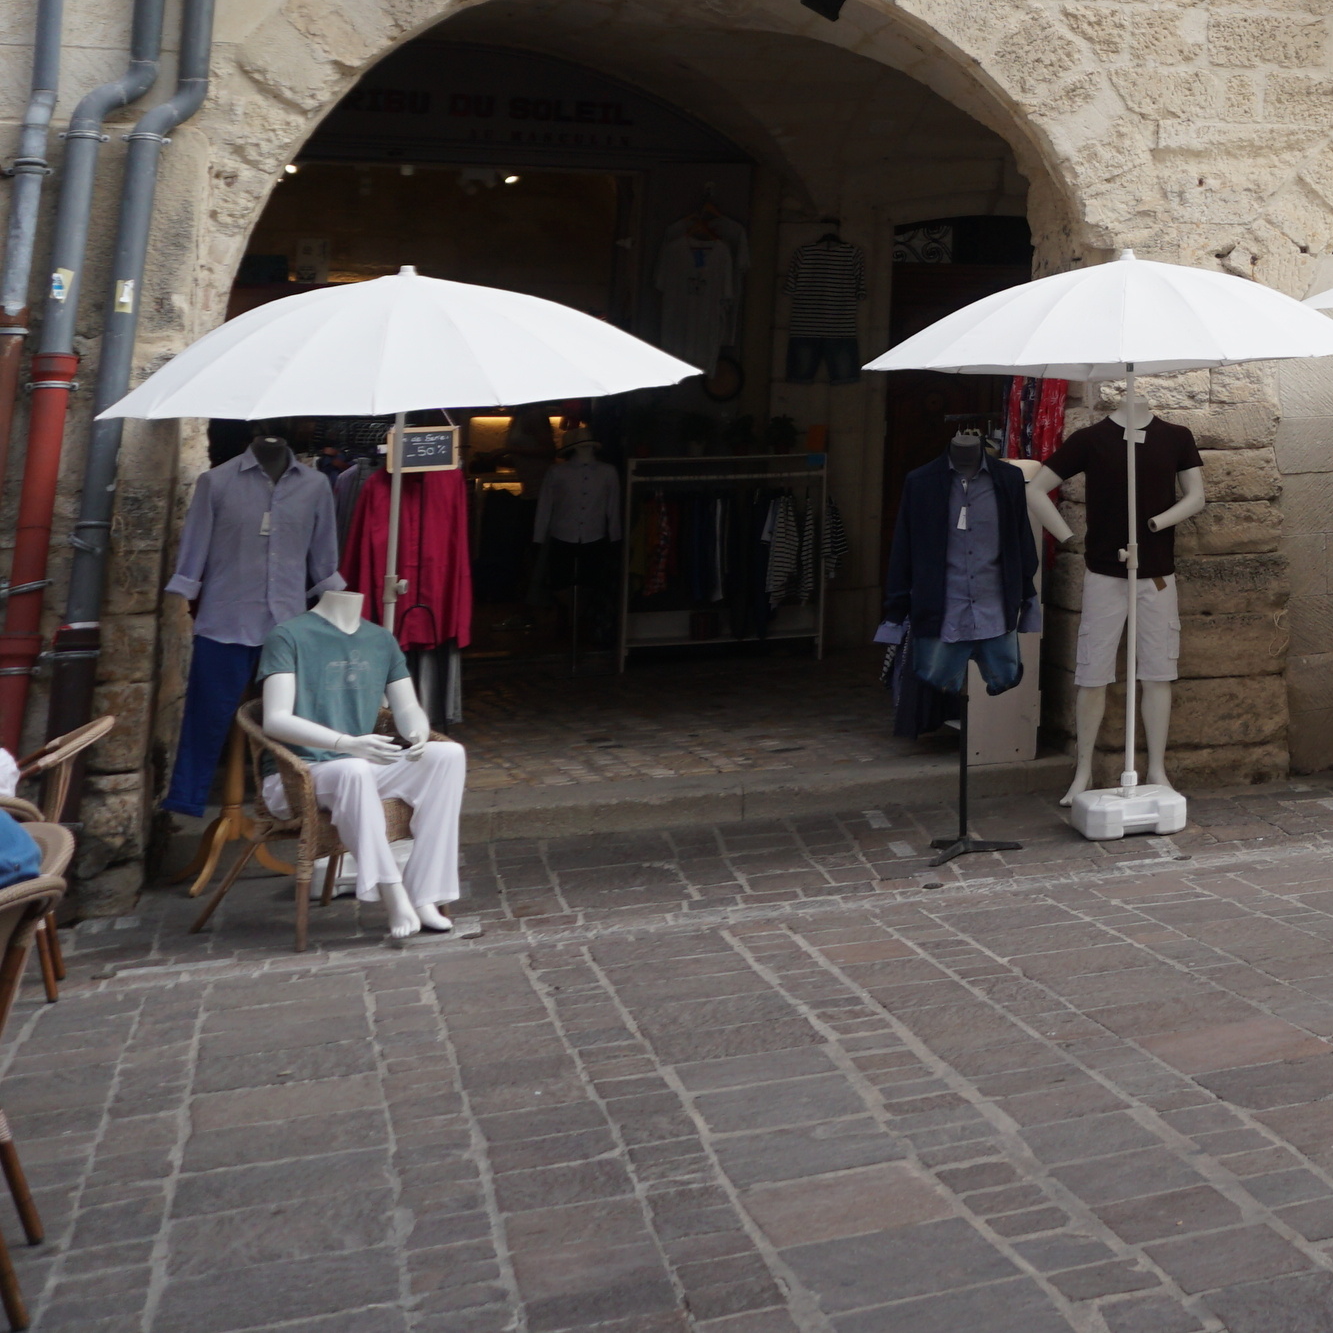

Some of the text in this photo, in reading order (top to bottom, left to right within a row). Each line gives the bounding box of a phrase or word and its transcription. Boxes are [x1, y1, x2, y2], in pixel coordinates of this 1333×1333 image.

[342, 86, 634, 126] RIBU DU SOLEIL
